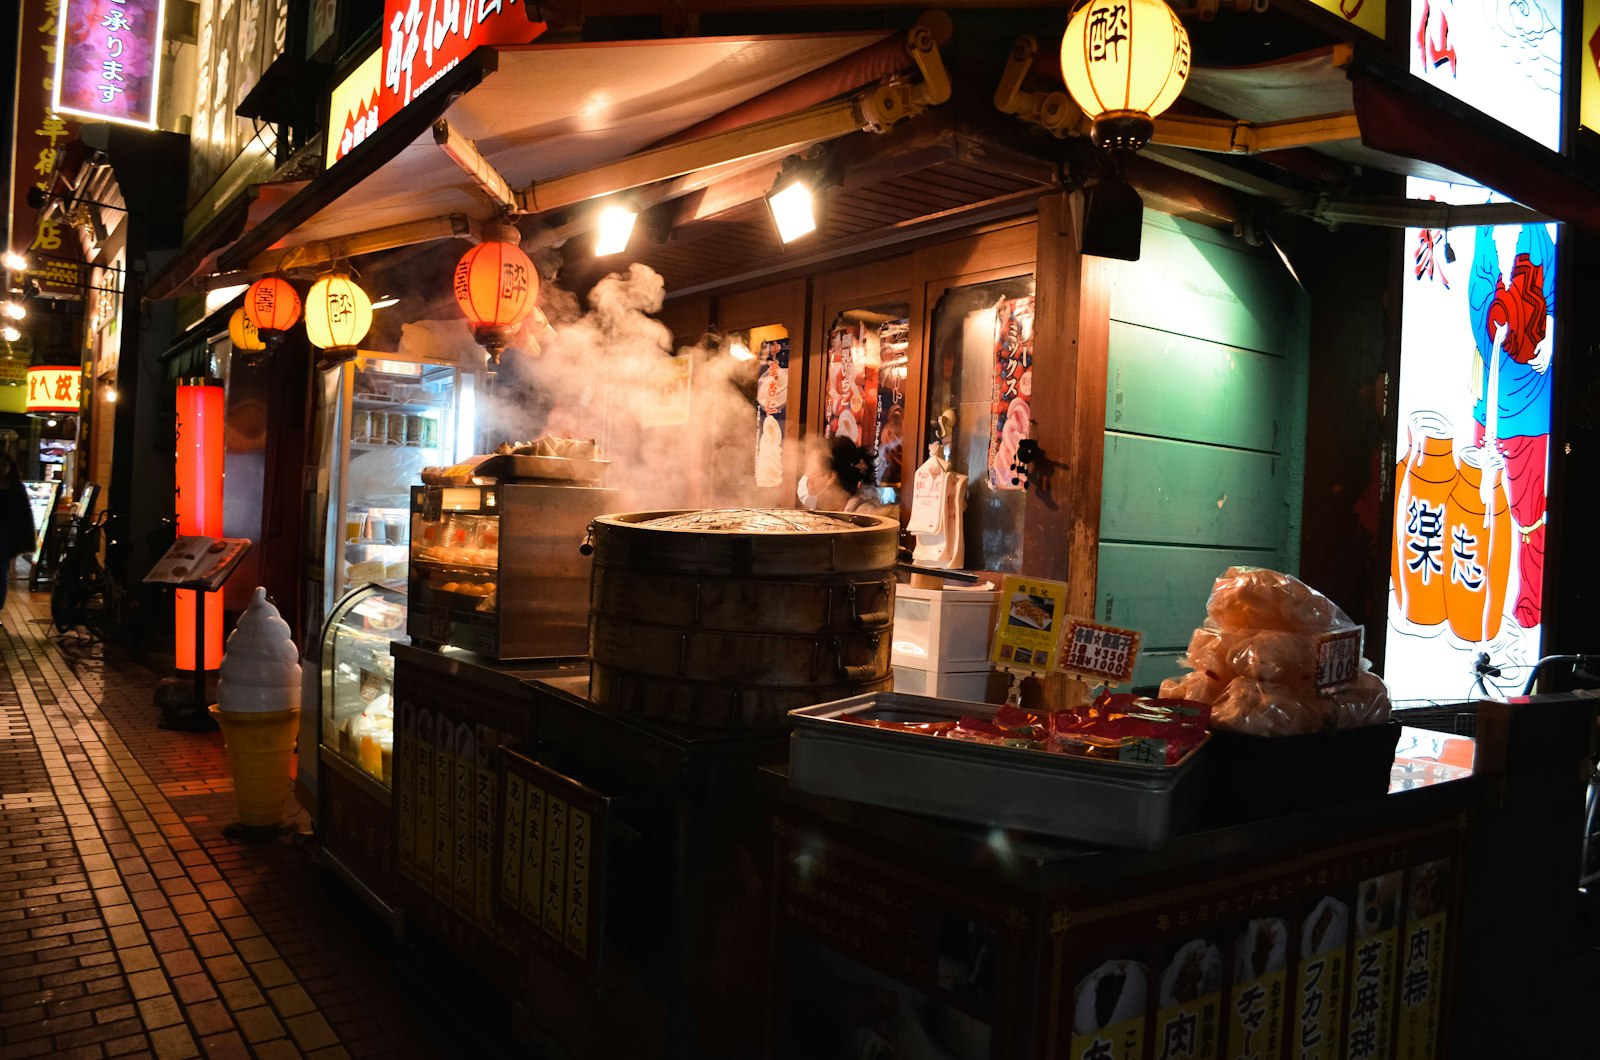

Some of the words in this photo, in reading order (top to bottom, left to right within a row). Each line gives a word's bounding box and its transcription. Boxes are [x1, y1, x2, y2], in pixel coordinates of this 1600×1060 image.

[98, 0, 131, 104] 承ります
[1089, 4, 1128, 63] 酔
[328, 292, 352, 325] 酔
[501, 263, 527, 303] 酔
[764, 341, 782, 416] 中華杏仁
[1004, 323, 1019, 397] ミックス
[1452, 527, 1484, 589] 志
[505, 780, 521, 880] あんまん
[526, 791, 542, 869] 肉まん
[1236, 985, 1266, 1060] チャー
[1300, 961, 1327, 1060] フカヒ
